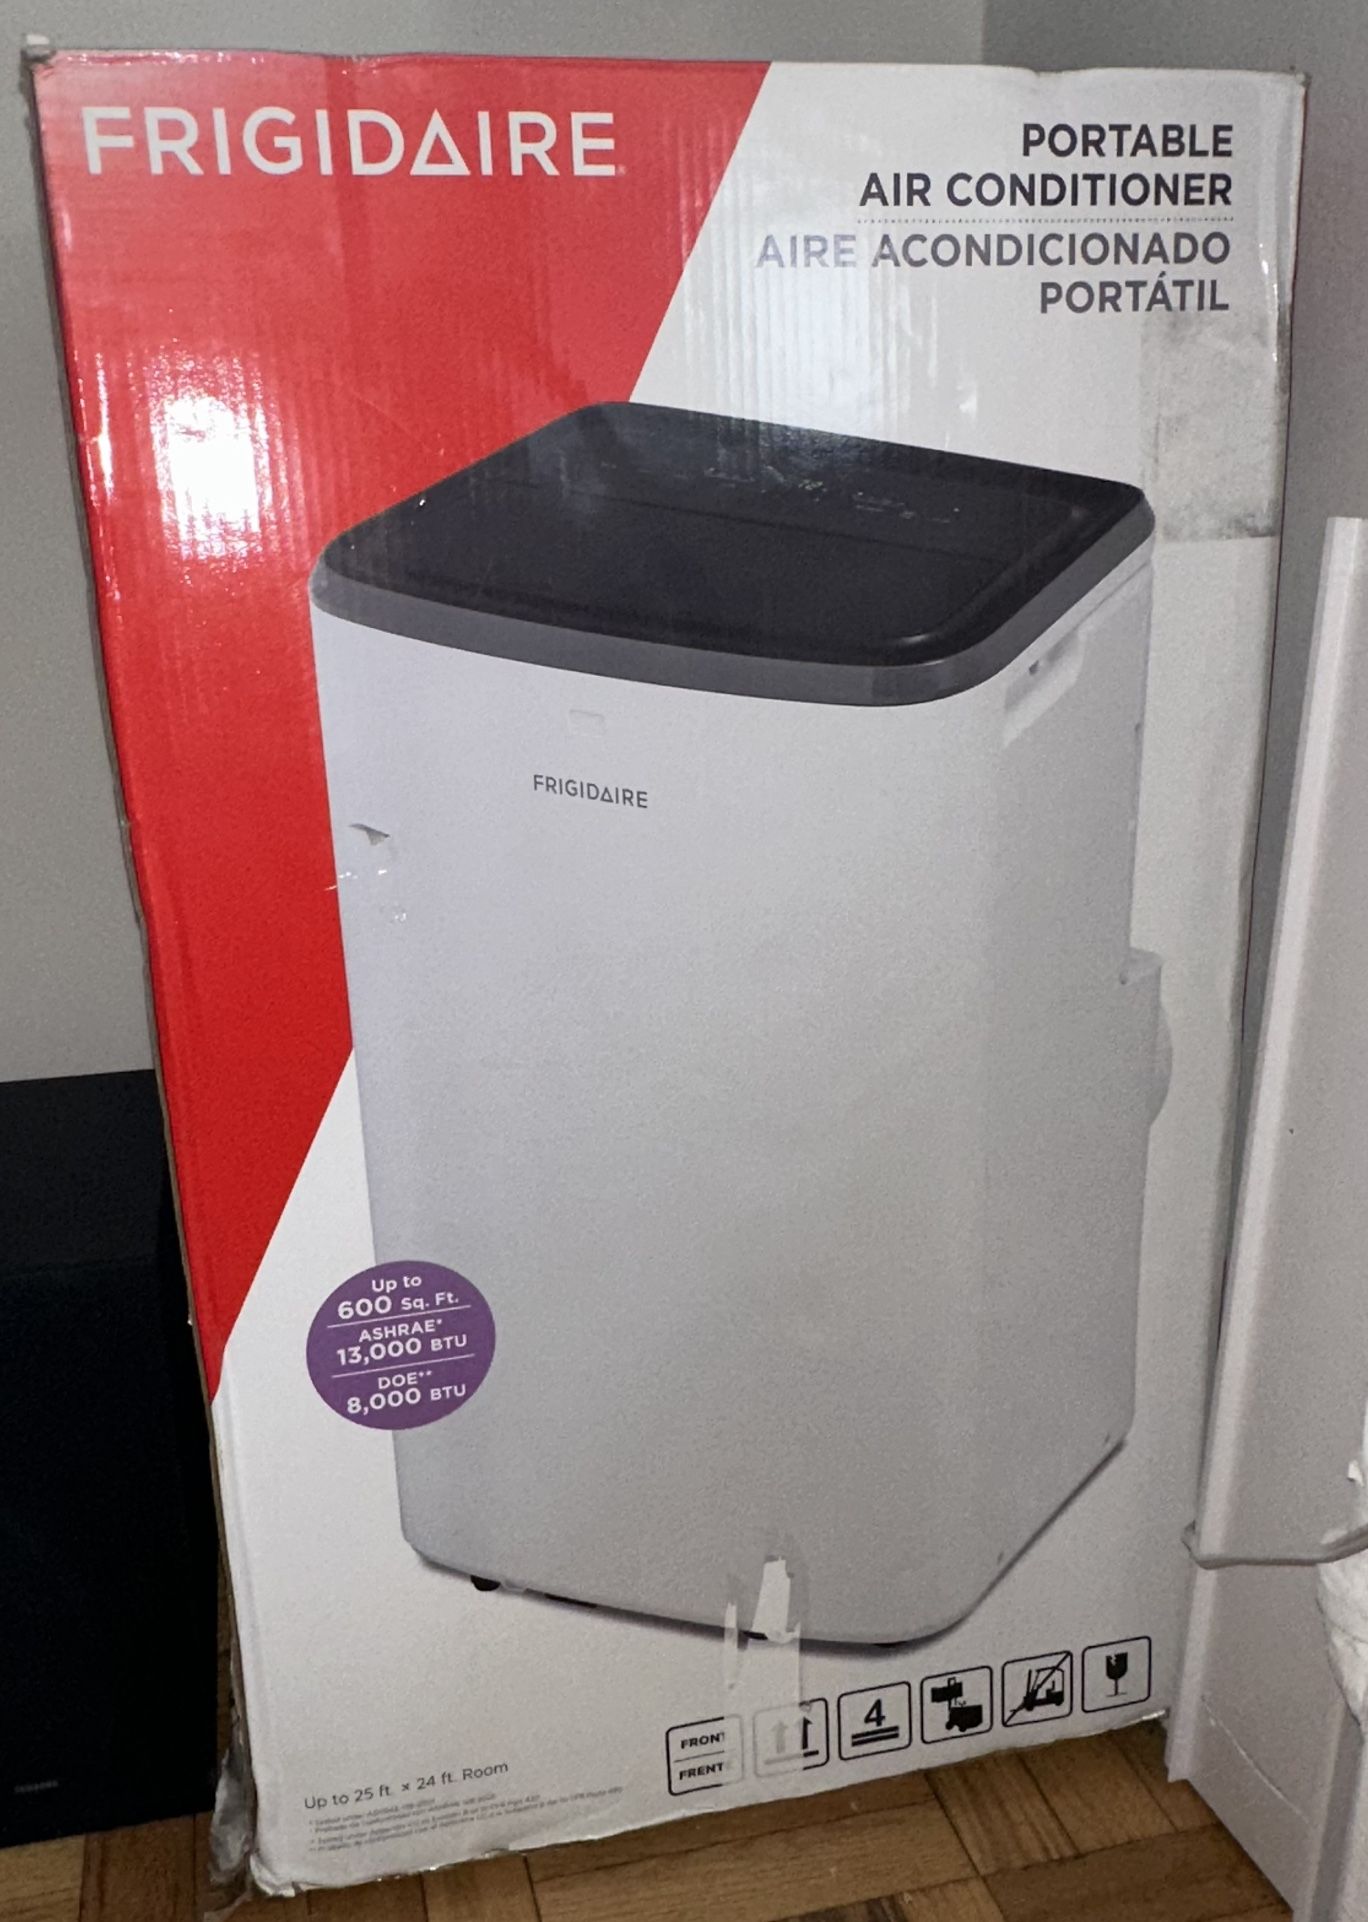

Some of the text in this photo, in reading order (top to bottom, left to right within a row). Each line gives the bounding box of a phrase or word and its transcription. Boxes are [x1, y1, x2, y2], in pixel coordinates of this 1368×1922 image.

[82, 106, 616, 176] FRIGIDAIRE
[1022, 123, 1233, 157] PORTABLE
[859, 172, 1232, 208] AIR CONDITIONER
[755, 231, 1231, 268] AIRE ACONDICIONADO
[1040, 271, 1229, 314] PORTÁTIL
[533, 774, 648, 808] FRIGIDAIRE
[371, 1275, 422, 1293] Up to
[337, 1291, 459, 1320] 600 Sq. Ft.
[336, 1334, 467, 1365] 13,000 BTU
[347, 1384, 467, 1416] 8,000 BTU
[863, 1698, 886, 1728] 4
[304, 1796, 327, 1810] Up
[332, 1794, 349, 1806] to
[354, 1787, 374, 1802] 25
[416, 1776, 436, 1791] 24
[462, 1762, 509, 1781] Room
